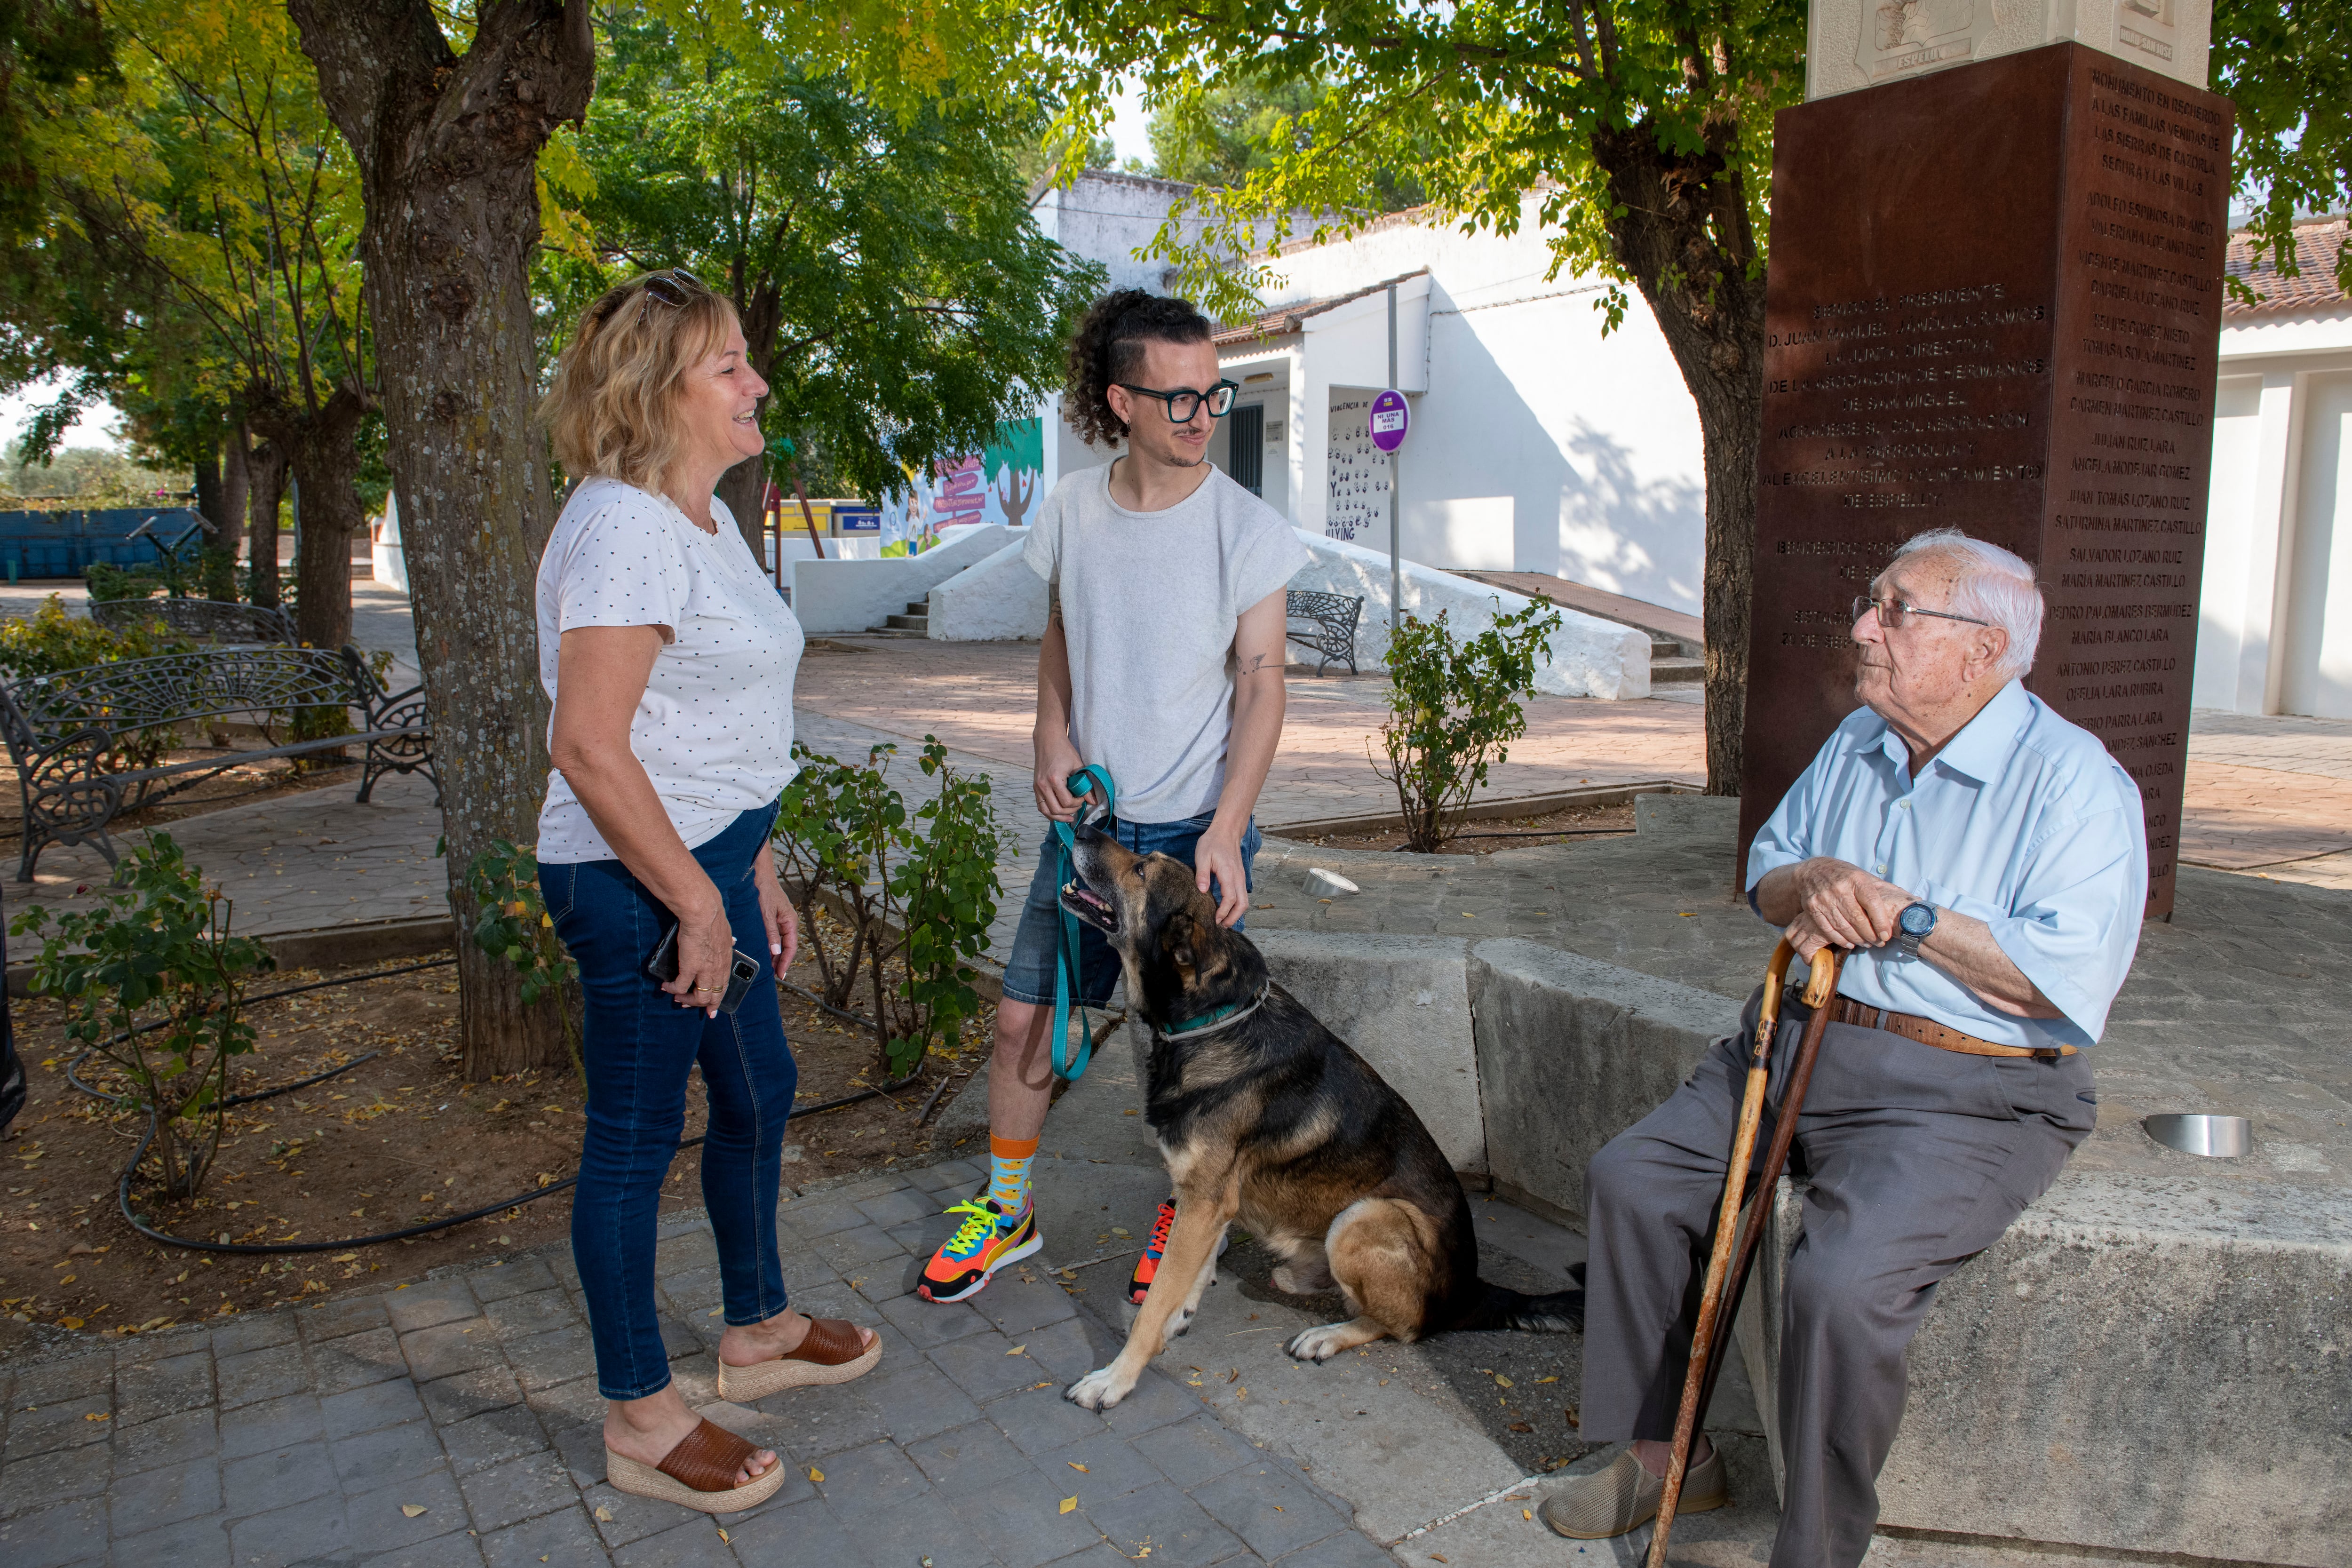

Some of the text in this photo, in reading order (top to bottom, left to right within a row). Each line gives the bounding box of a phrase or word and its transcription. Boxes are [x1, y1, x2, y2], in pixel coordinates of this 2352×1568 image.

[2121, 29, 2138, 46] HDAD
[2142, 37, 2155, 52] SAN
[2093, 69, 2220, 125] MONUMENTO EN RECUERDO
[2092, 98, 2219, 151] A LAS FAMILIAS VENIDAS DE
[2095, 126, 2113, 142] LAS
[2117, 132, 2156, 156] SIERRAS
[2159, 146, 2171, 162] DE
[2102, 155, 2202, 197] SEGURA Y LAS VILLAS
[2086, 192, 2212, 237] ADOLFO ESPINOSA BLANCO
[2092, 219, 2205, 260] VALERIANA LOZANO RUIZ
[2078, 249, 2119, 274] VICENTE
[2170, 271, 2211, 293] CASTILLO
[2090, 279, 2200, 315] GABRIELA LOZANO RUIZ
[2094, 313, 2126, 333] FELIPE
[2164, 328, 2189, 344] NIETO
[2082, 338, 2122, 358] TOMASA
[2125, 346, 2149, 363] SOLA
[1769, 380, 1788, 393] DE
[1917, 367, 1938, 382] DE
[1944, 358, 2044, 380] HERMANOS
[2077, 371, 2123, 391] MARCELO
[2164, 383, 2201, 402] ROMERO
[1330, 401, 1359, 413] VIOLENCIA
[1843, 391, 1968, 412] DE SAN MIGUEL
[2070, 397, 2111, 416] CARMEN
[2162, 409, 2203, 427] CASTILLO
[1966, 441, 1978, 455] Y
[2127, 436, 2148, 452] RUIZ
[2150, 438, 2175, 454] LARA
[1843, 494, 1863, 508] DE
[2067, 490, 2092, 505] JUAN
[2131, 494, 2168, 508] LOZANO
[2170, 496, 2191, 510] RUIZ
[2055, 515, 2110, 532] SATURNINA
[2161, 520, 2201, 534] CASTILLO
[2070, 548, 2183, 564] SALVADOR LOZANO RUIZ
[1840, 566, 1859, 579] DE
[2143, 574, 2185, 588] CASTILLO
[2049, 605, 2083, 620] PEDRO
[2085, 605, 2143, 619] PALOMARES
[1802, 634, 1819, 647] DE
[2105, 630, 2142, 644] BLANCO
[2145, 629, 2169, 642] LARA
[2056, 661, 2099, 677] ANTONIO
[2133, 658, 2176, 672] CASTILLO
[2066, 686, 2100, 702] OFELIA
[2103, 684, 2128, 699] LARA
[2105, 714, 2137, 729] PARRA
[2138, 711, 2162, 725] LARA
[2145, 762, 2173, 777] OJEDA
